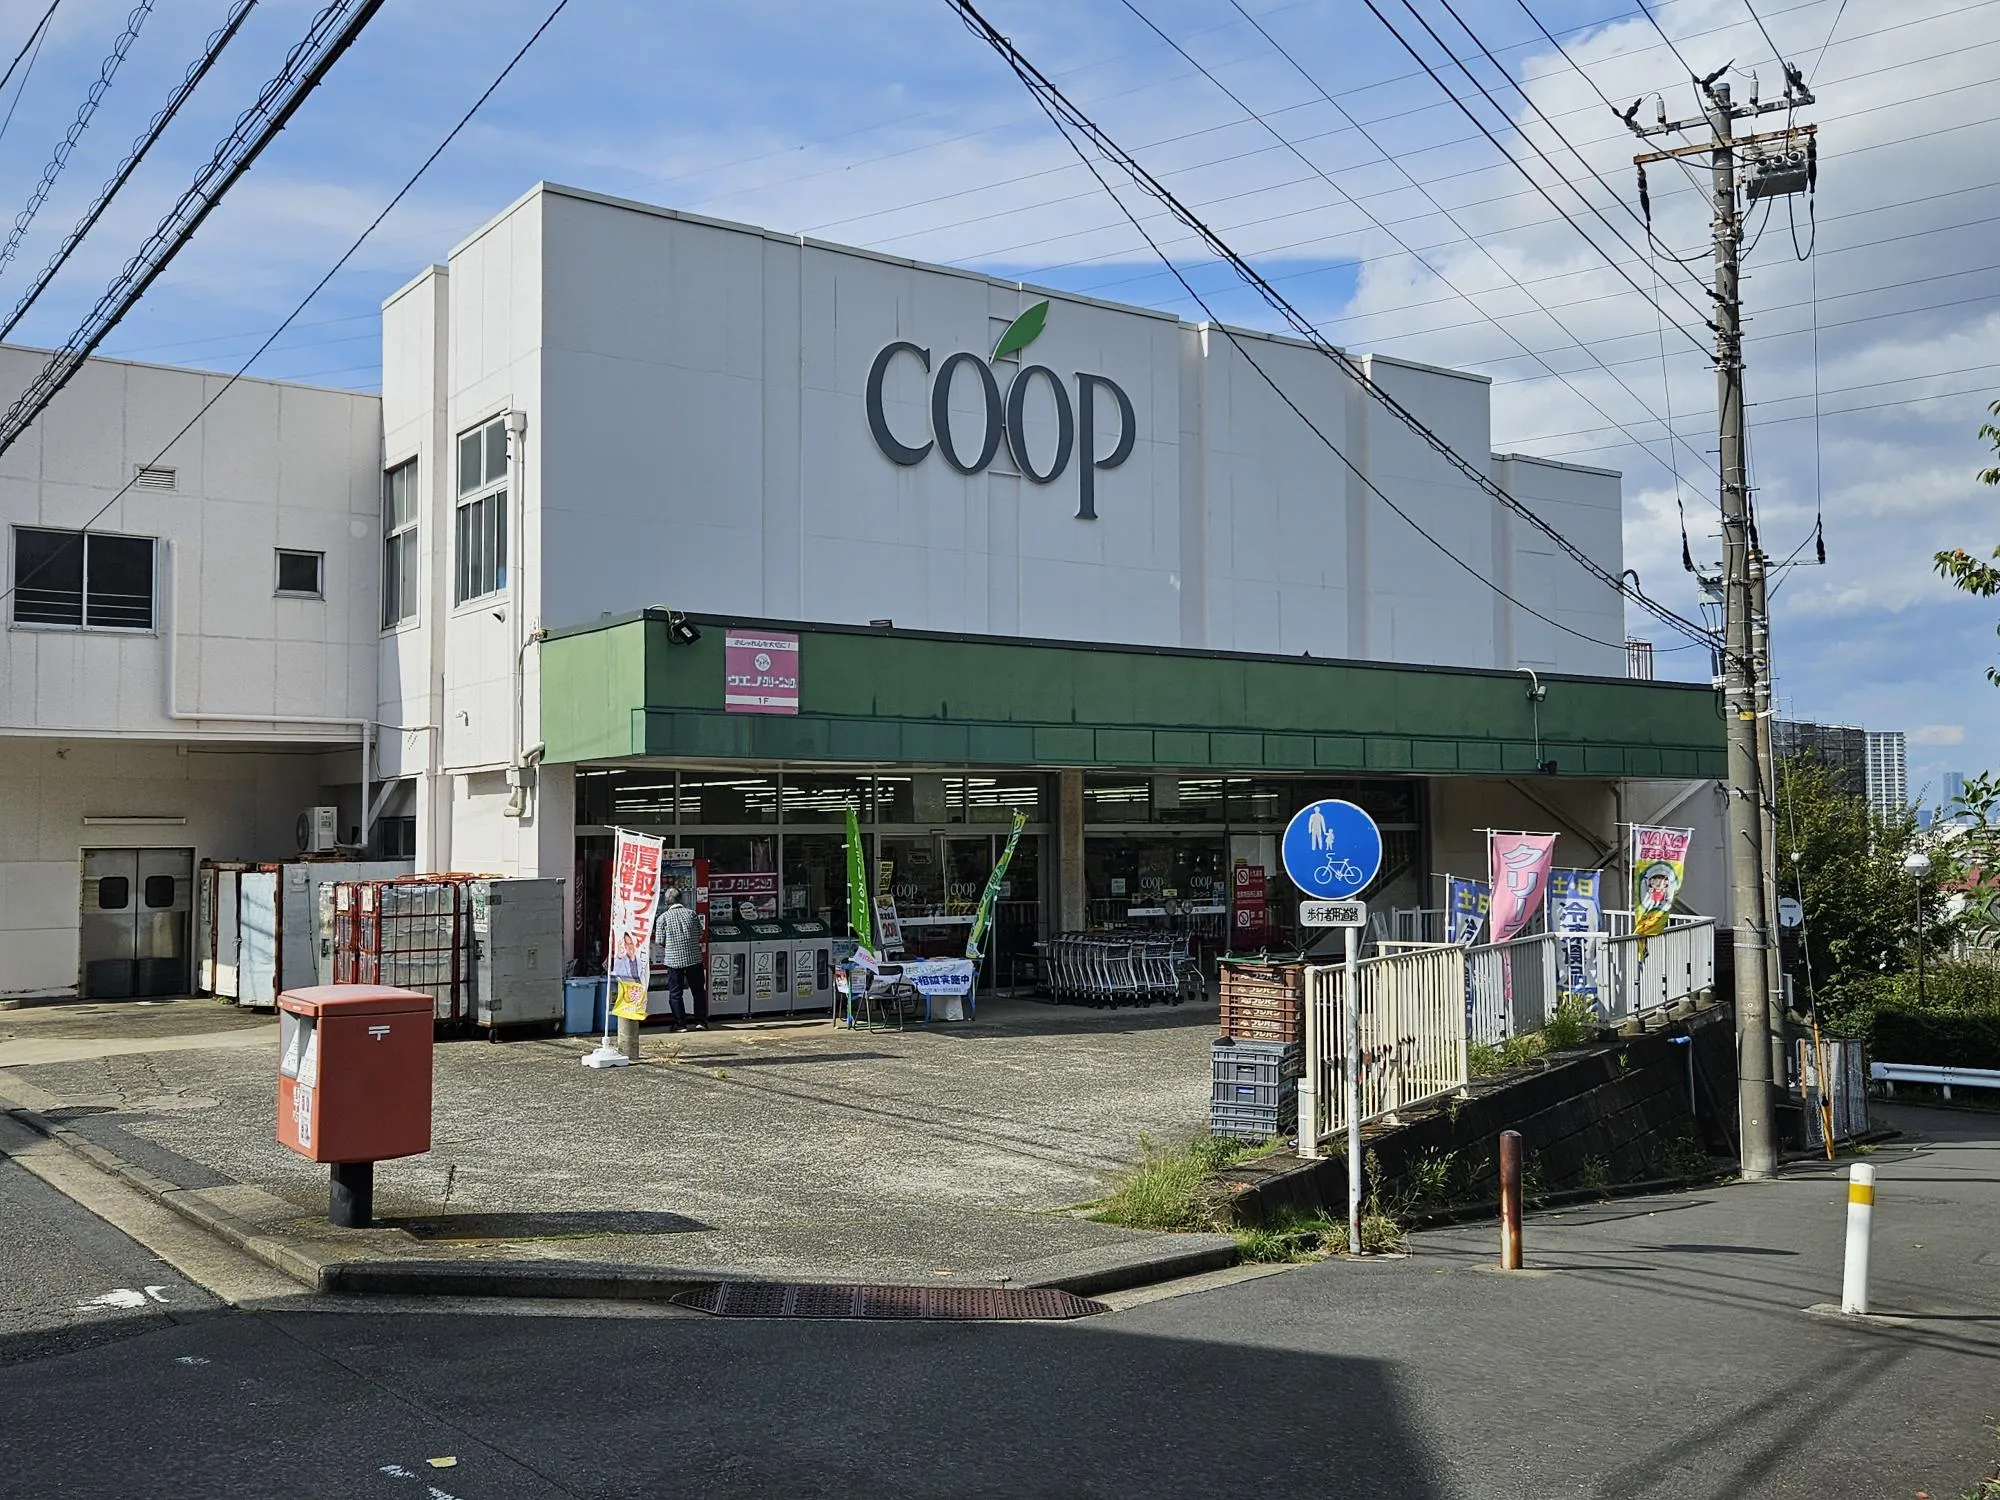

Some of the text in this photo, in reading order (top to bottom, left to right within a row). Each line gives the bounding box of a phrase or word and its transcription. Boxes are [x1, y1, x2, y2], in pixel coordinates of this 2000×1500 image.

[708, 878, 773, 890] エノクリーニング
[1307, 907, 1359, 922] 歩行者用道路
